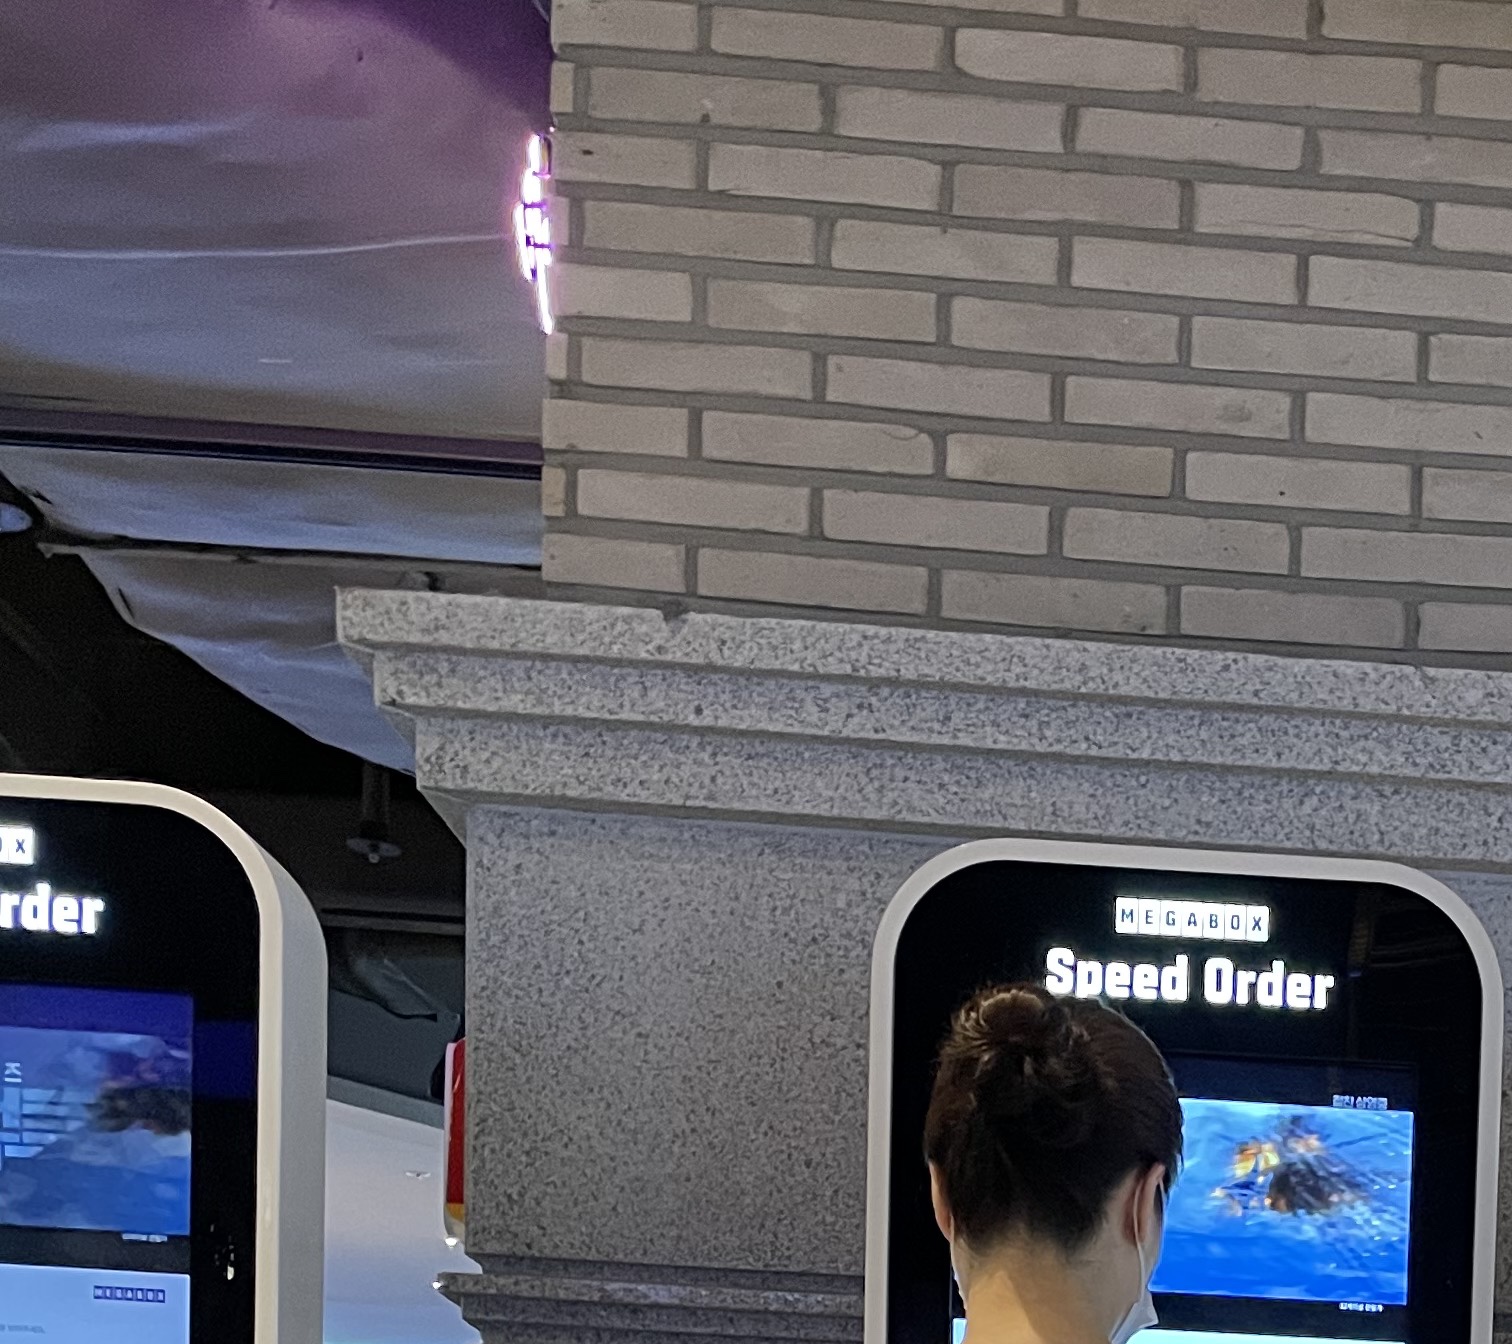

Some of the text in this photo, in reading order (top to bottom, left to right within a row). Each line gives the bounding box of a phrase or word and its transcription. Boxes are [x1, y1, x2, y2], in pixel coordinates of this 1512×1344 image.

[1119, 905, 1263, 934] MEGABOX
[1045, 947, 1335, 1010] Speed Order
